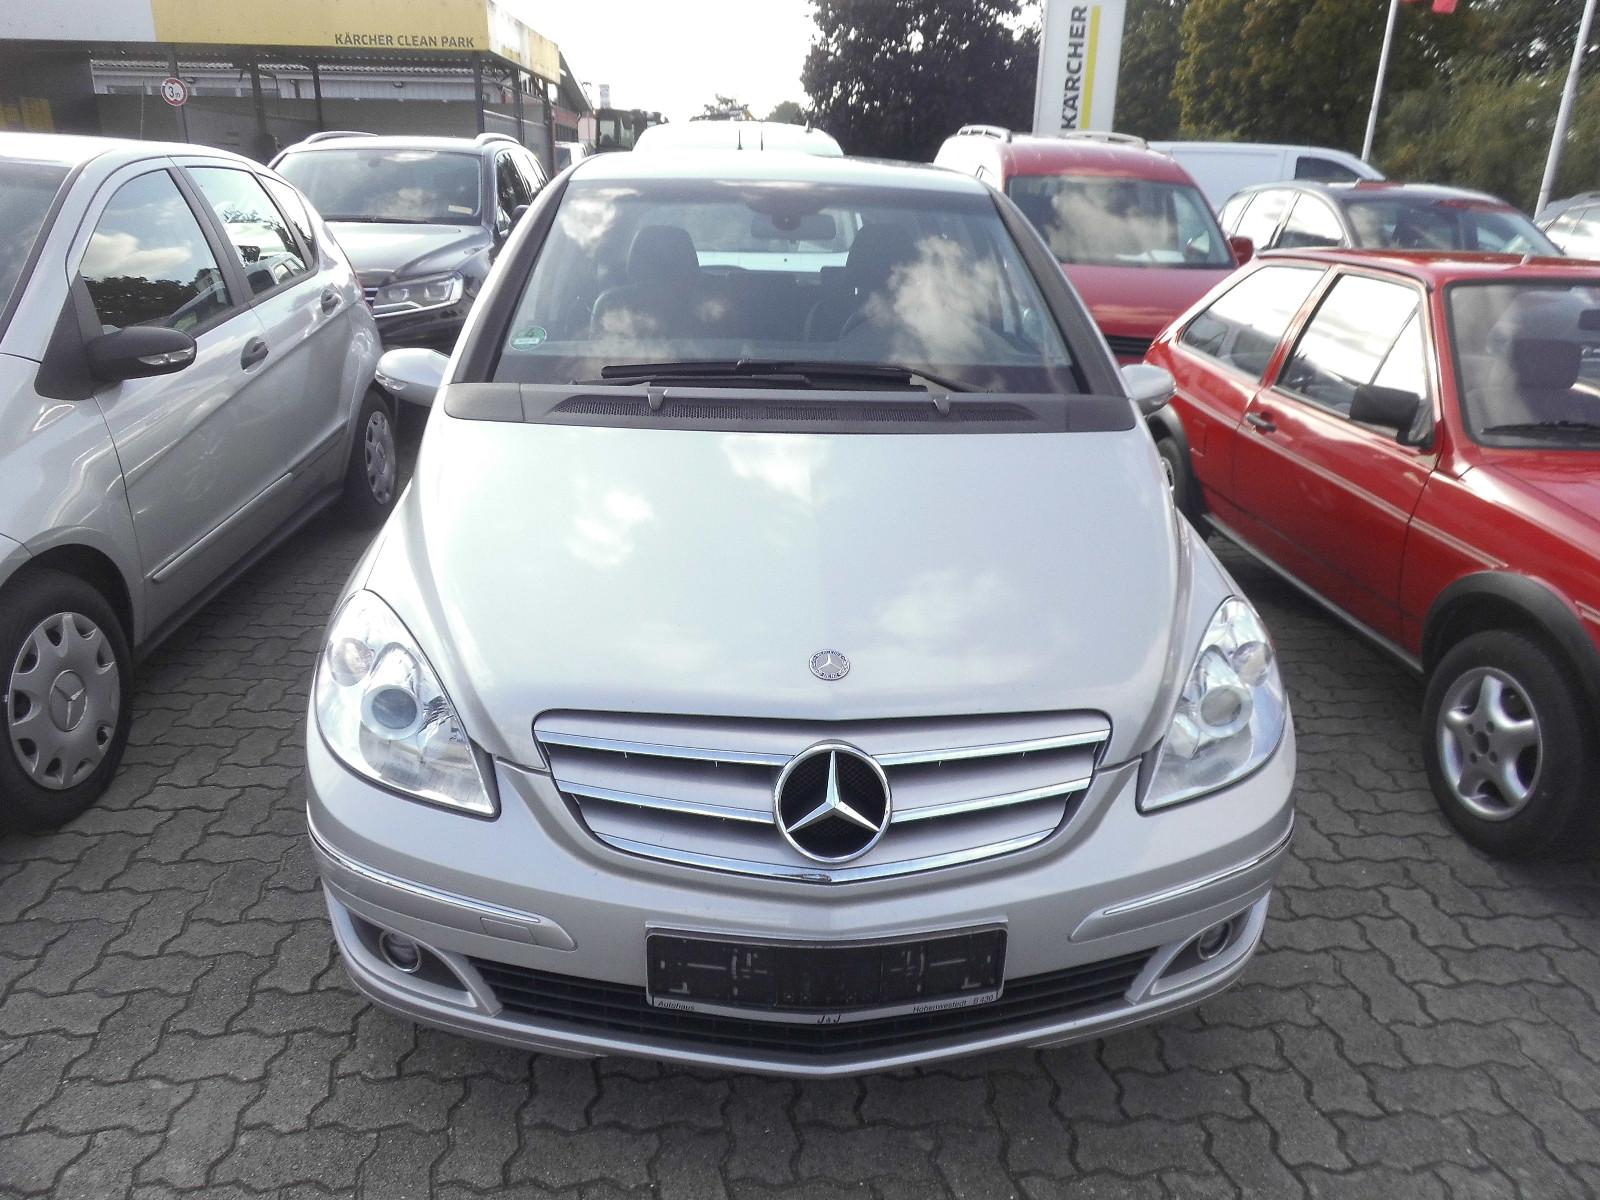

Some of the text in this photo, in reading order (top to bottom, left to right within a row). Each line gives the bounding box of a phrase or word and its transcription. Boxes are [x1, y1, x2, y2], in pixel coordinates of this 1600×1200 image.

[334, 32, 475, 48] KÄRCHER CLEAN PARK
[1061, 5, 1088, 130] KÄRCHER
[658, 1000, 695, 1011] Autohaus
